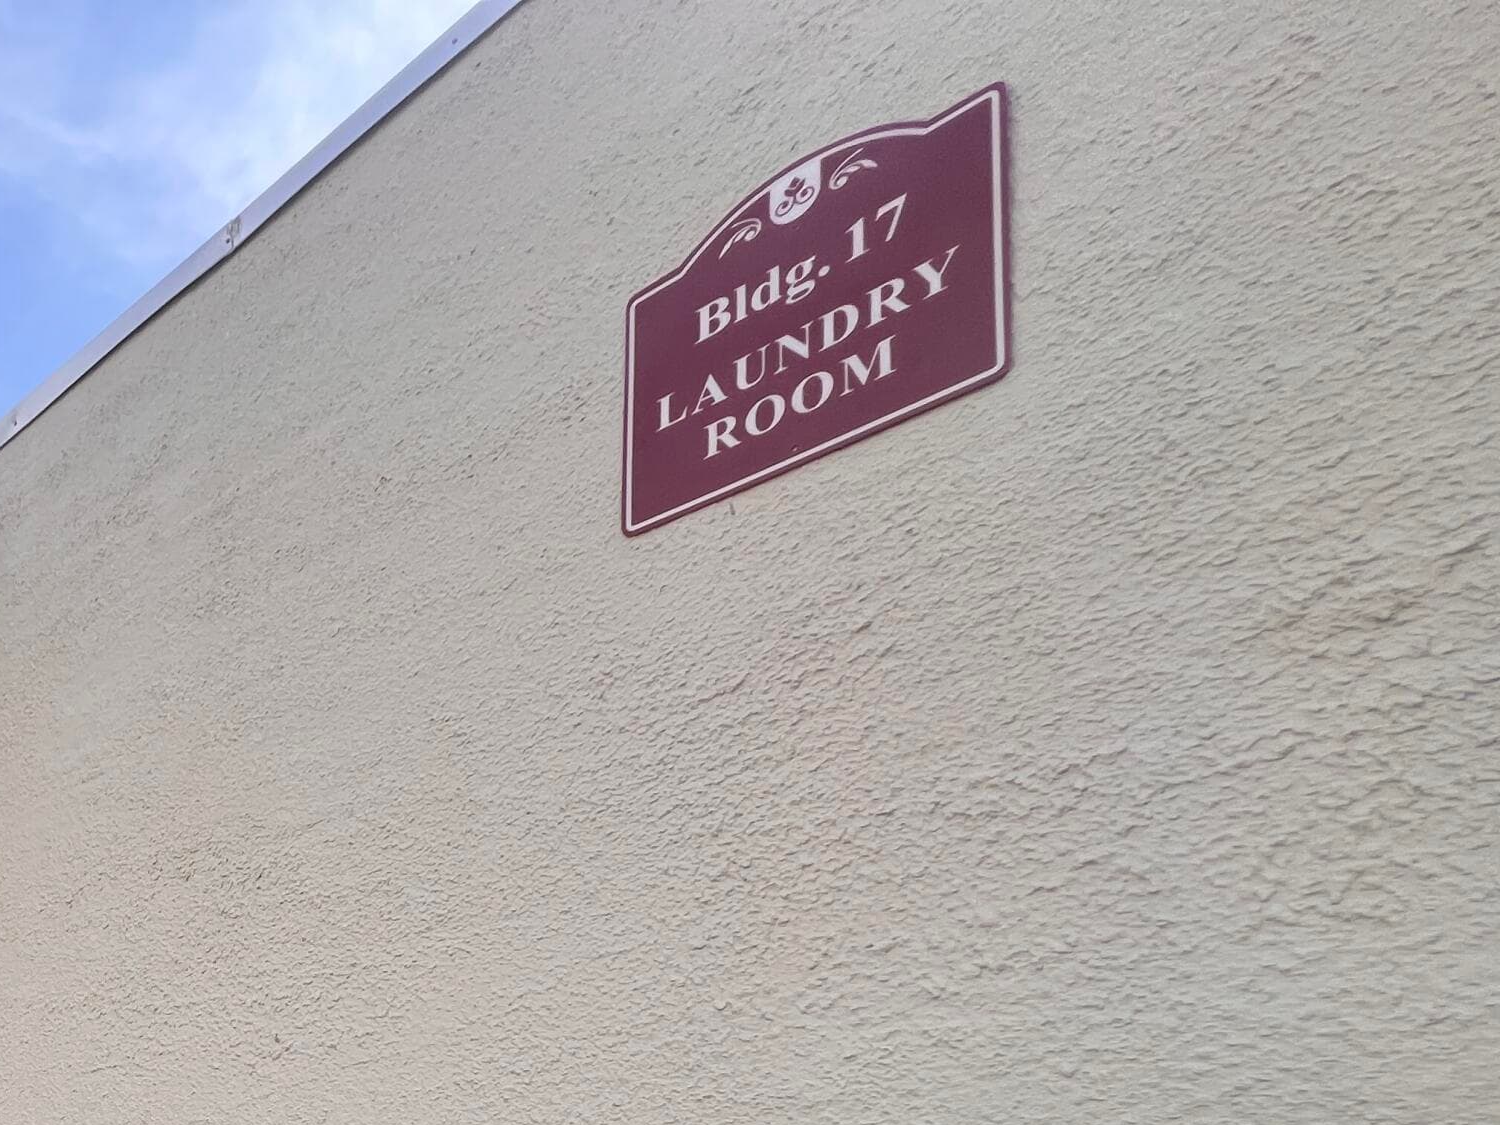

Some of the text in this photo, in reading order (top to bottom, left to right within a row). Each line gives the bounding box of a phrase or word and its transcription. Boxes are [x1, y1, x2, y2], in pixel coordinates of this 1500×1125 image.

[655, 244, 960, 433] LAUNDRY
[693, 193, 908, 344] Bldg. 17
[702, 335, 897, 460] ROOM
